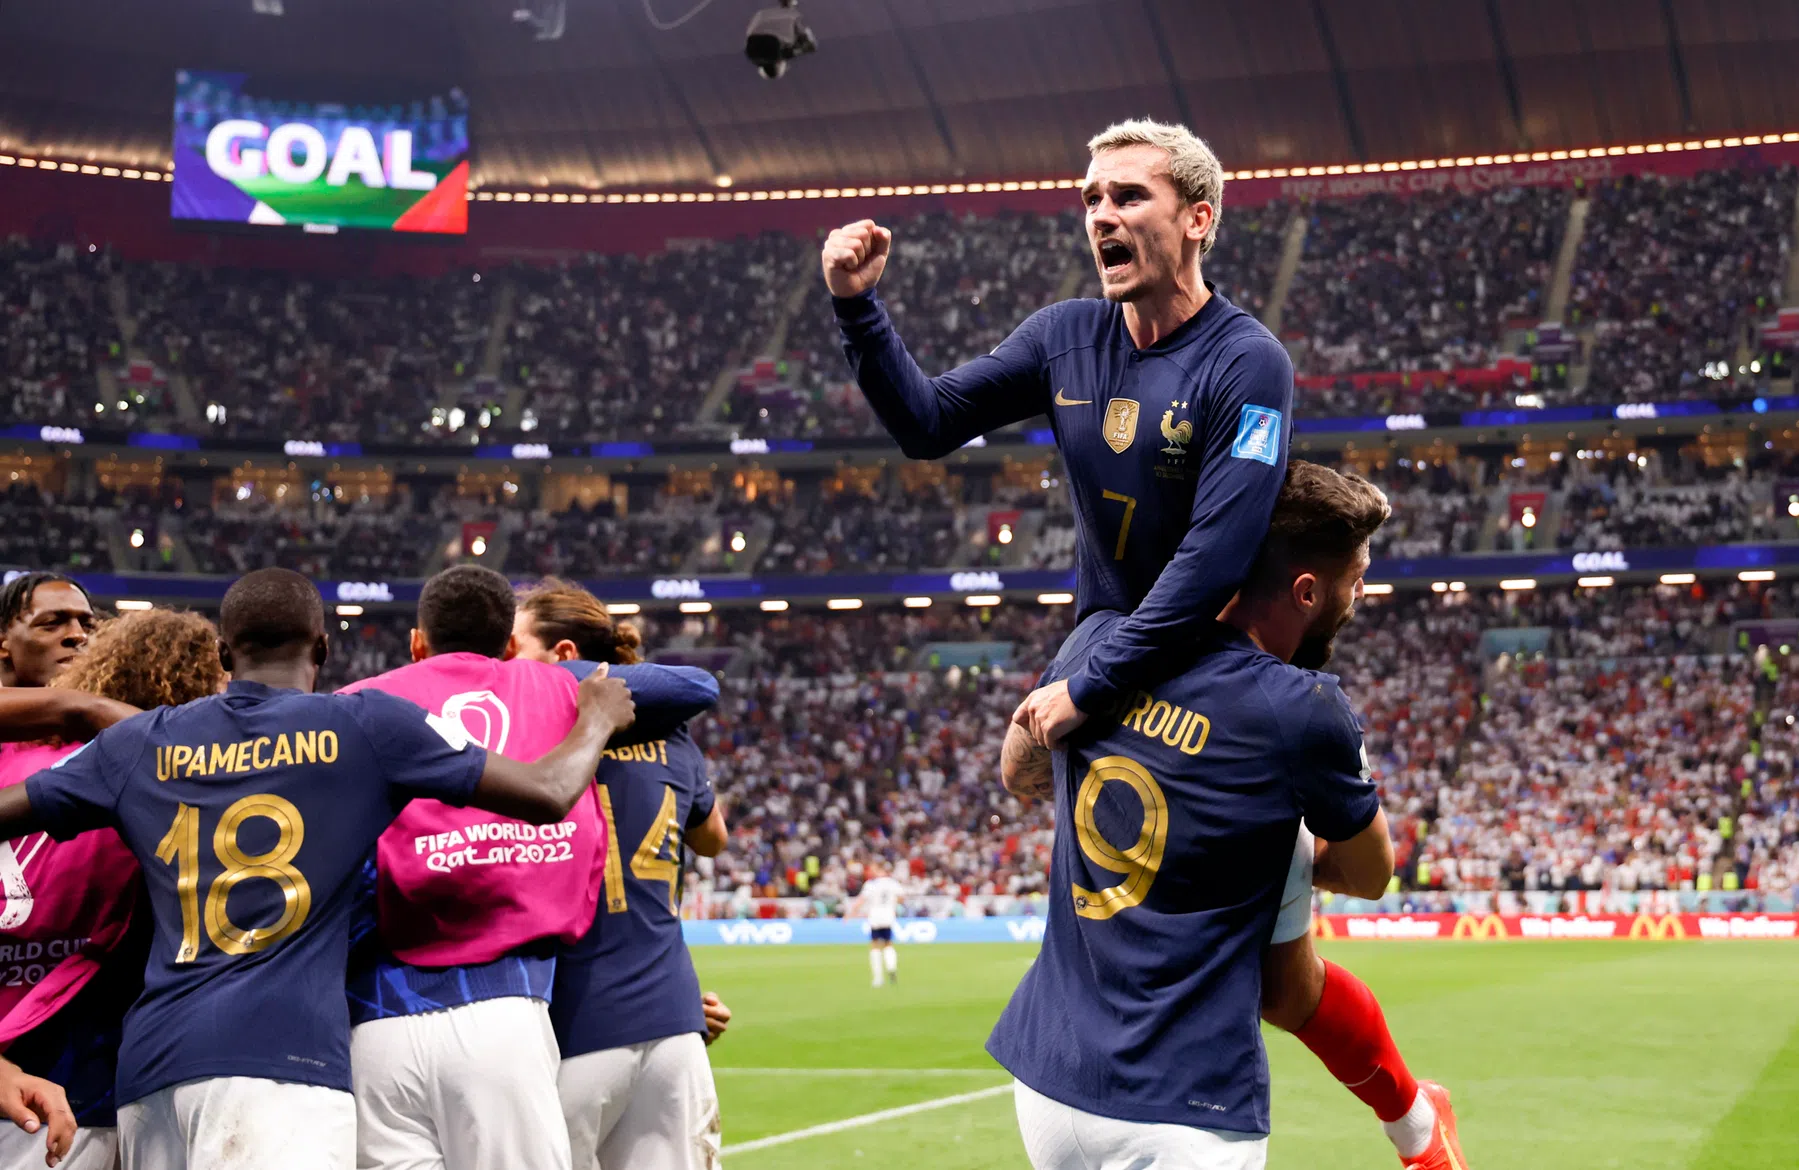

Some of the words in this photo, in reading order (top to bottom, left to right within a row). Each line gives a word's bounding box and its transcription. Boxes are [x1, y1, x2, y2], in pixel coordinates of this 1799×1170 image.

[205, 119, 438, 191] GOAL
[1102, 489, 1137, 561] 7
[156, 730, 339, 782] UPAMECANO
[1116, 690, 1211, 756] ROUD
[414, 830, 465, 855] FIFA
[464, 822, 537, 843] WORLD
[538, 821, 577, 841] CUP
[426, 841, 574, 873] Qatar2022
[597, 784, 680, 918] 14
[1073, 755, 1169, 920] 9
[155, 793, 311, 963] 18
[0, 942, 43, 962] RLD
